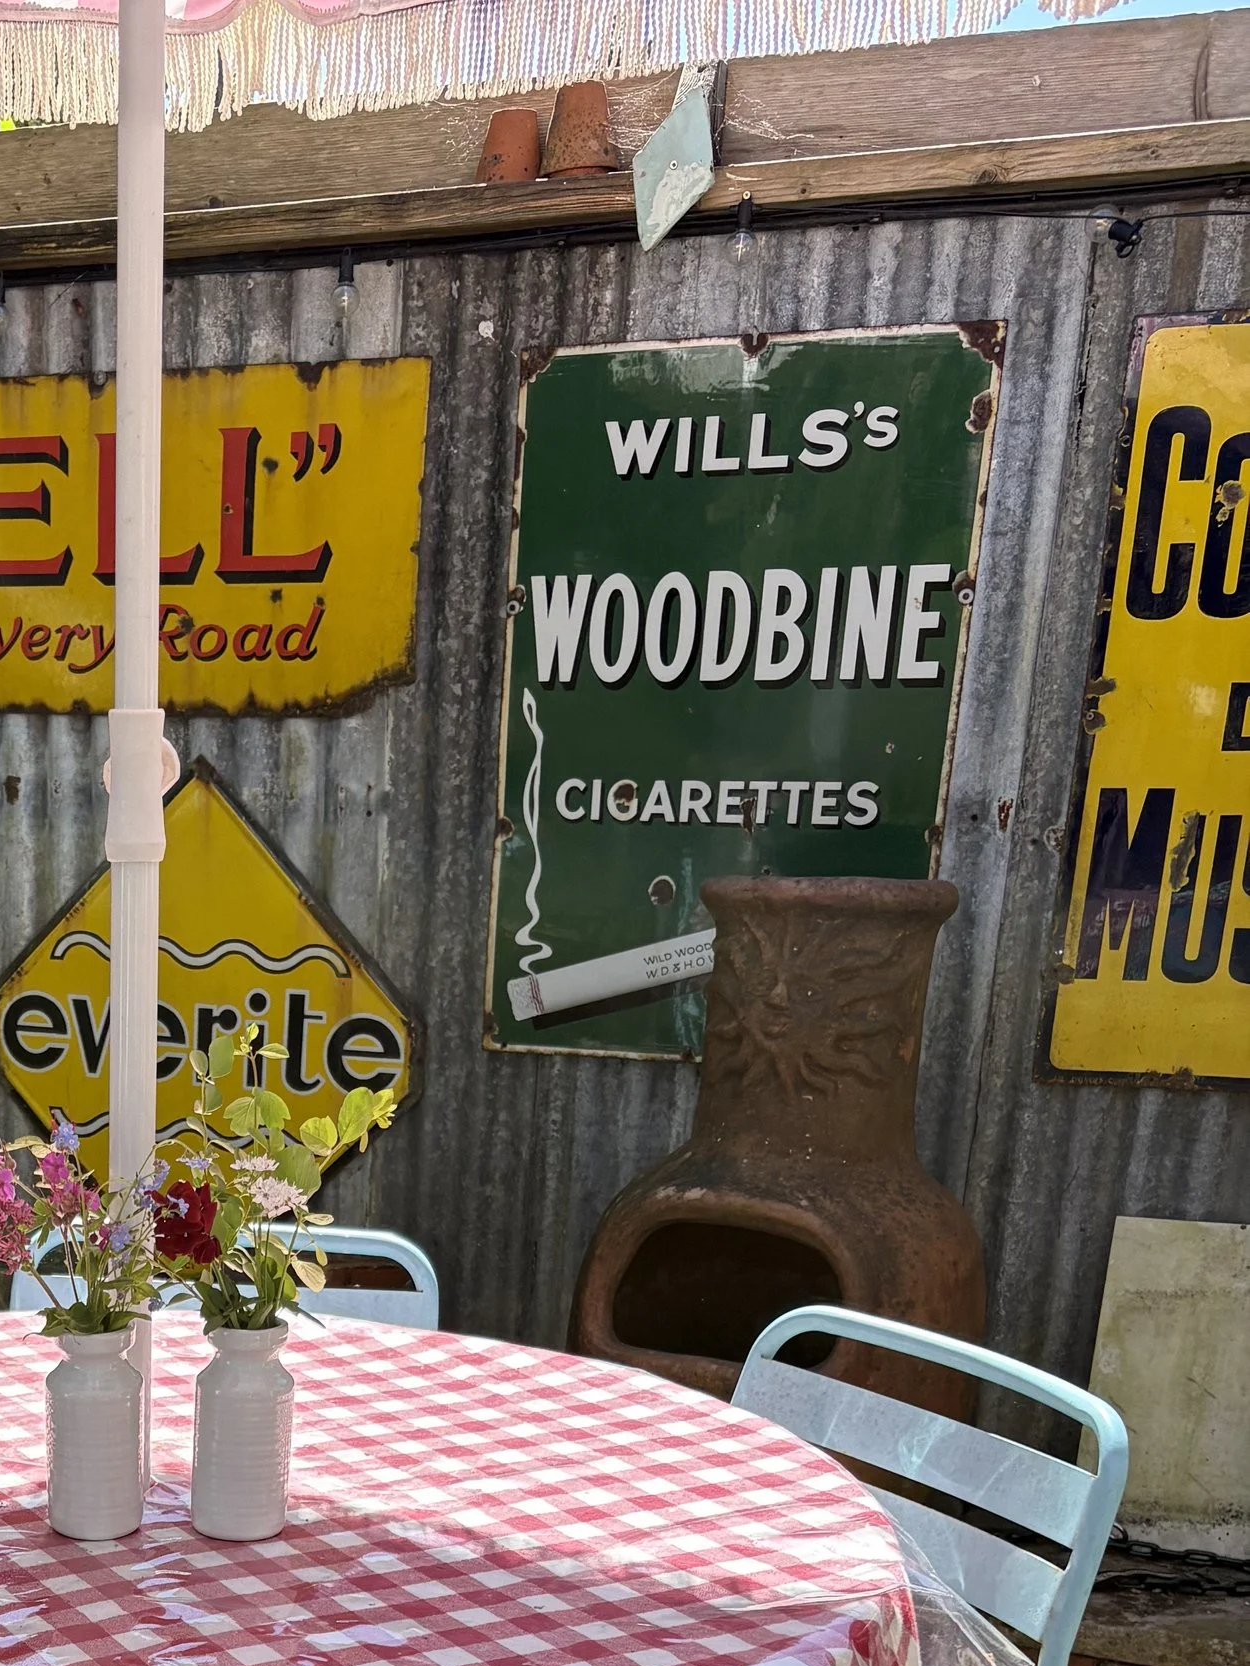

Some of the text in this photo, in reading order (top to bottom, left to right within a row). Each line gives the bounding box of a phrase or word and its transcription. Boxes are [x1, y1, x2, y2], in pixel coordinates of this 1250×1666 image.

[530, 563, 953, 686] WOODBINE
[555, 779, 881, 826] CIGARETTES
[643, 953, 672, 966] WILD
